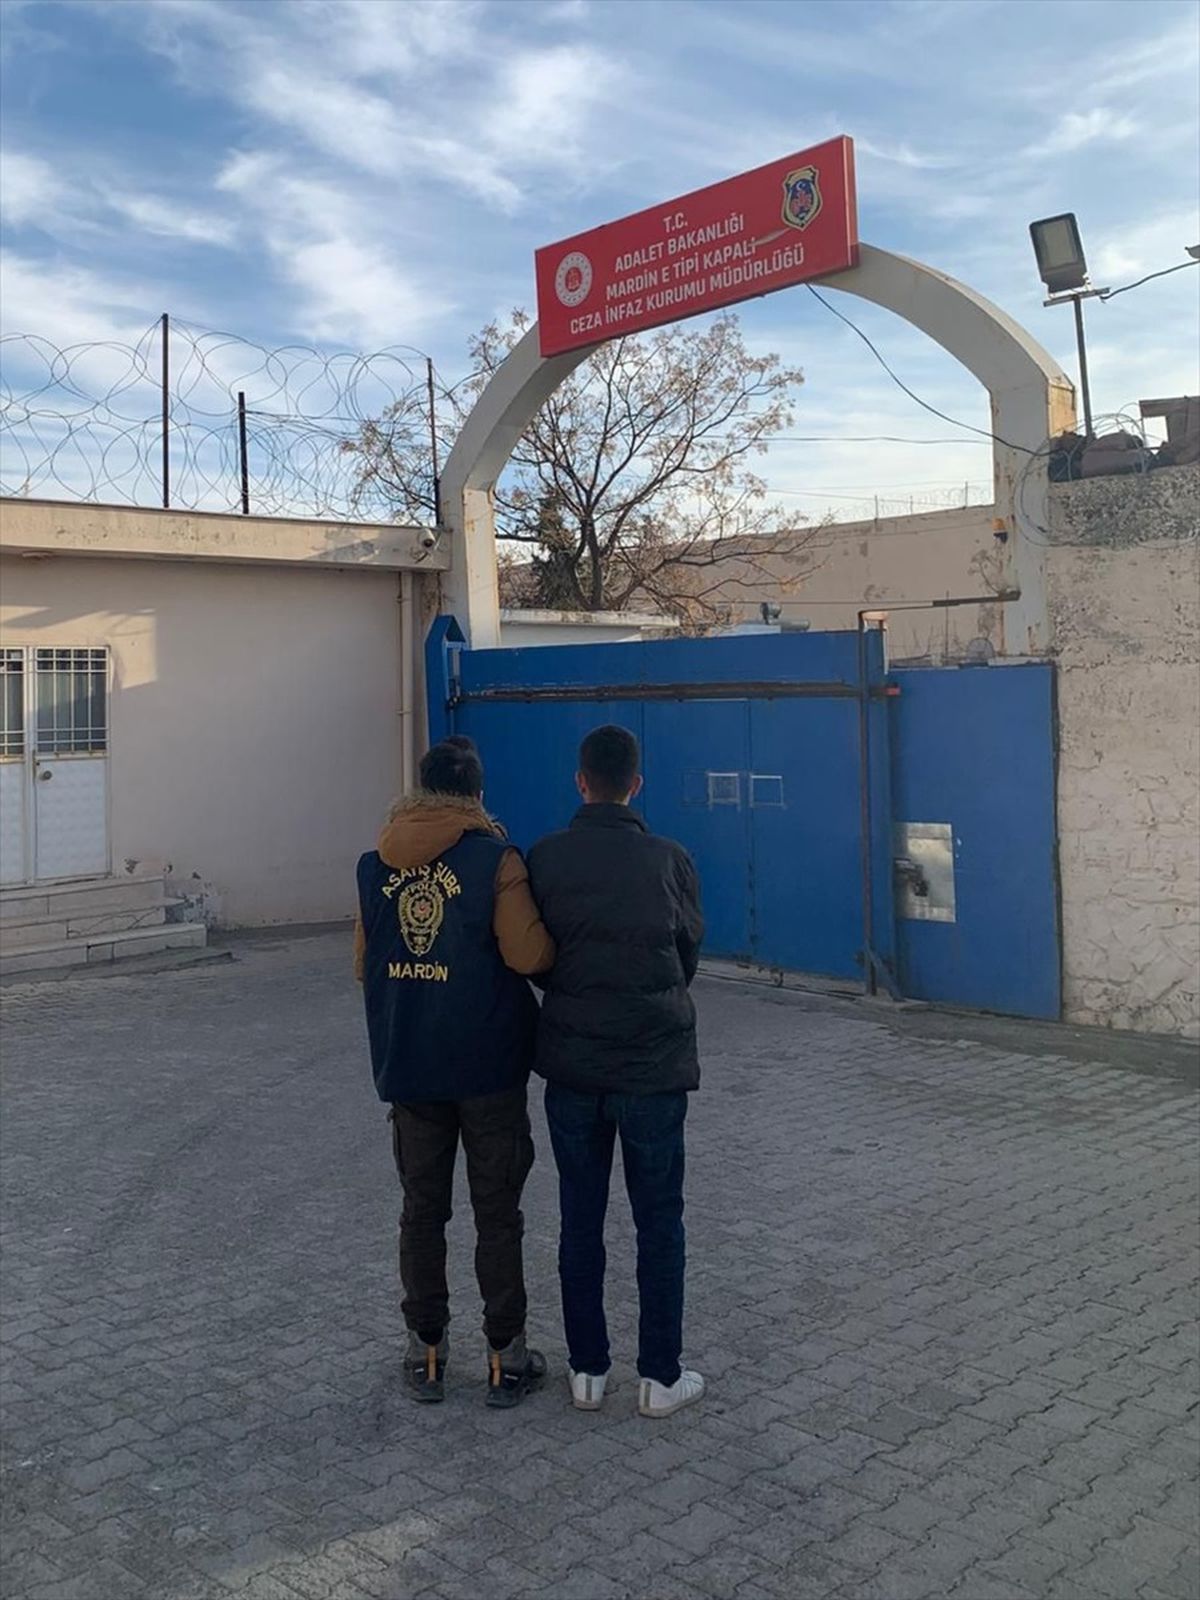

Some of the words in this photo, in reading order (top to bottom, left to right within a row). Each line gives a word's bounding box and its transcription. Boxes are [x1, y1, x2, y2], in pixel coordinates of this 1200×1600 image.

[615, 242, 664, 273] ADALET
[667, 212, 744, 255] BAKANLIĞI
[663, 212, 688, 233] T.C.
[570, 311, 602, 335] CEZA
[605, 298, 643, 325] İNFAZ
[646, 278, 706, 310] KURUMU
[710, 242, 804, 289] MÜDÜRLÜĞÜ
[606, 269, 658, 300] MARDİN
[661, 266, 670, 283] E
[673, 252, 699, 280] TİPİ
[388, 961, 449, 982] MARDİN
